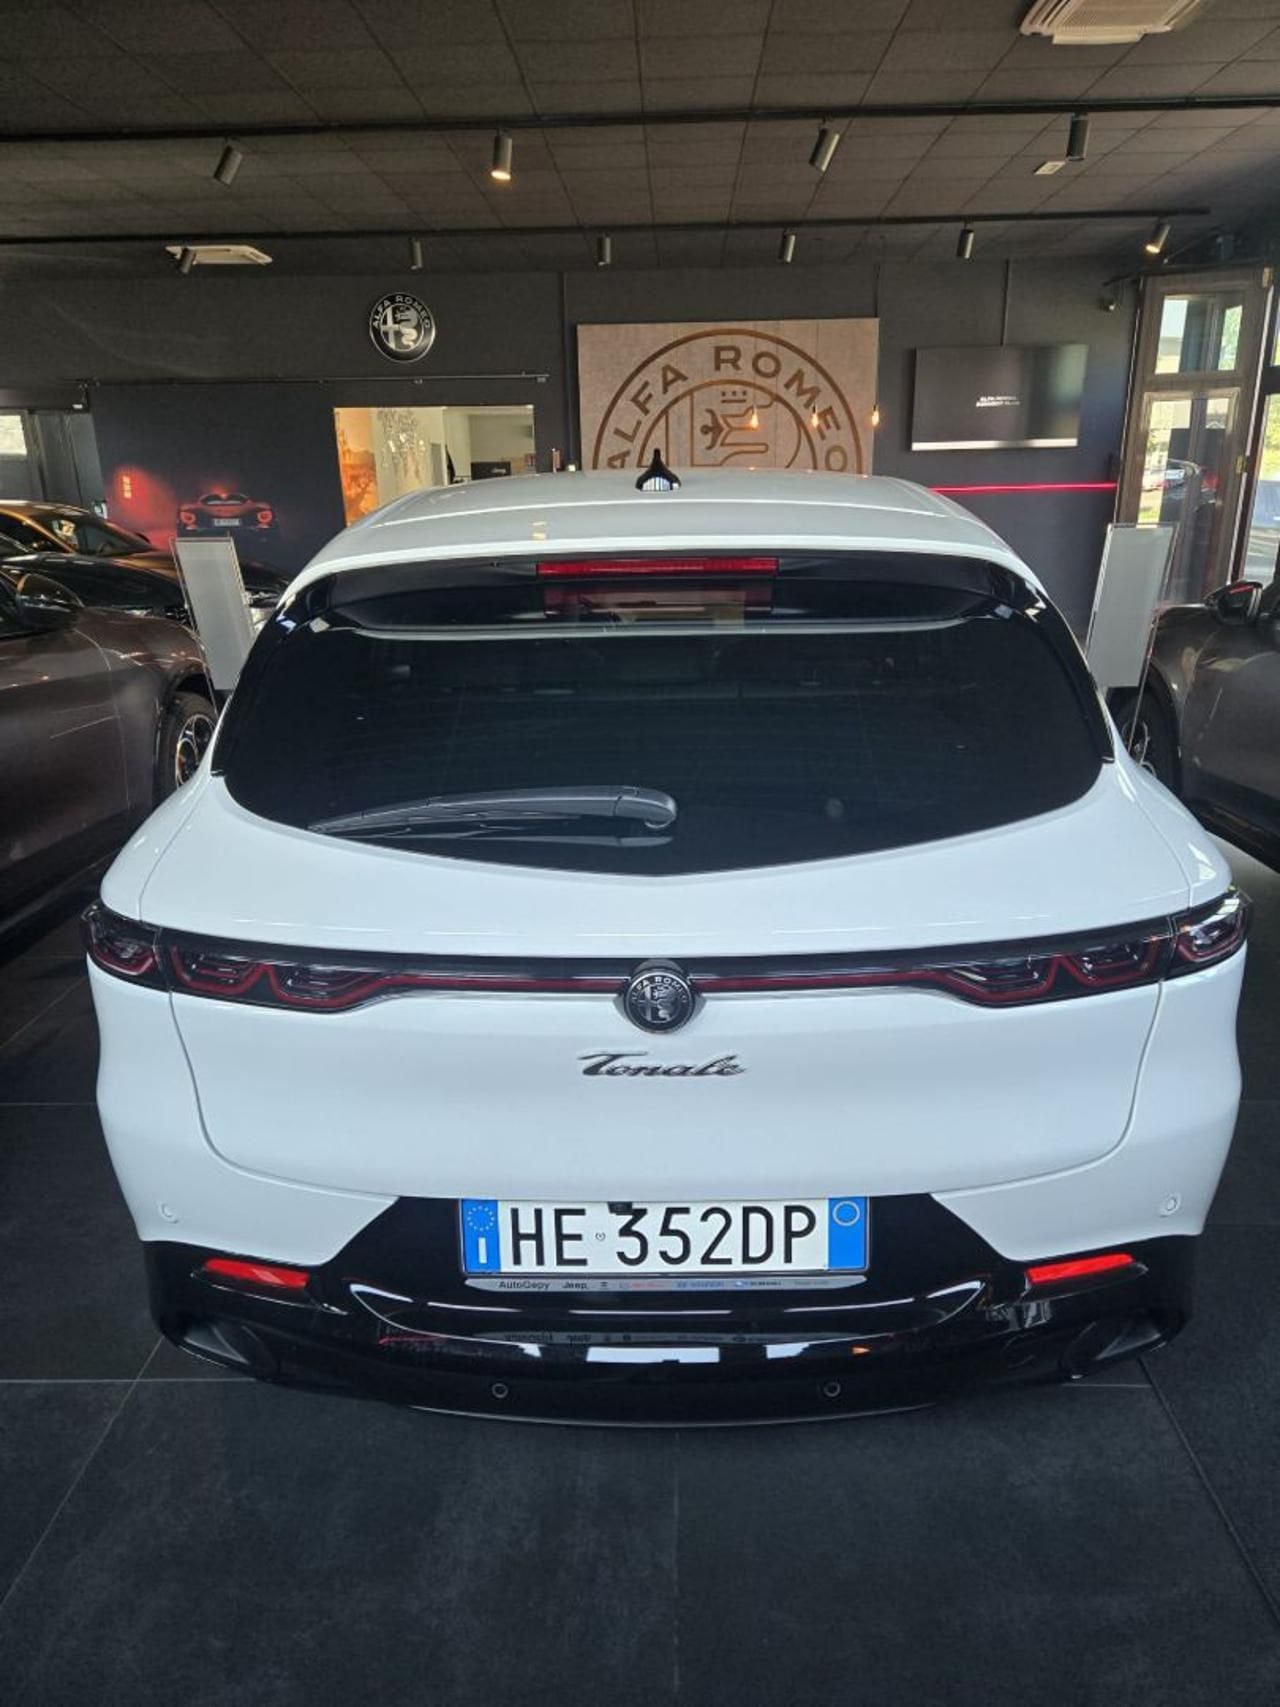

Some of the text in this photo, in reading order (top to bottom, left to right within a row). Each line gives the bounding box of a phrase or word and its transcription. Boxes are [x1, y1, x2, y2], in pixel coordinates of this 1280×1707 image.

[373, 295, 431, 329] ALFA ROMEO
[607, 345, 848, 473] ALFA ROMEO
[577, 1051, 748, 1076] Tonale
[510, 1204, 817, 1267] HE 352DP
